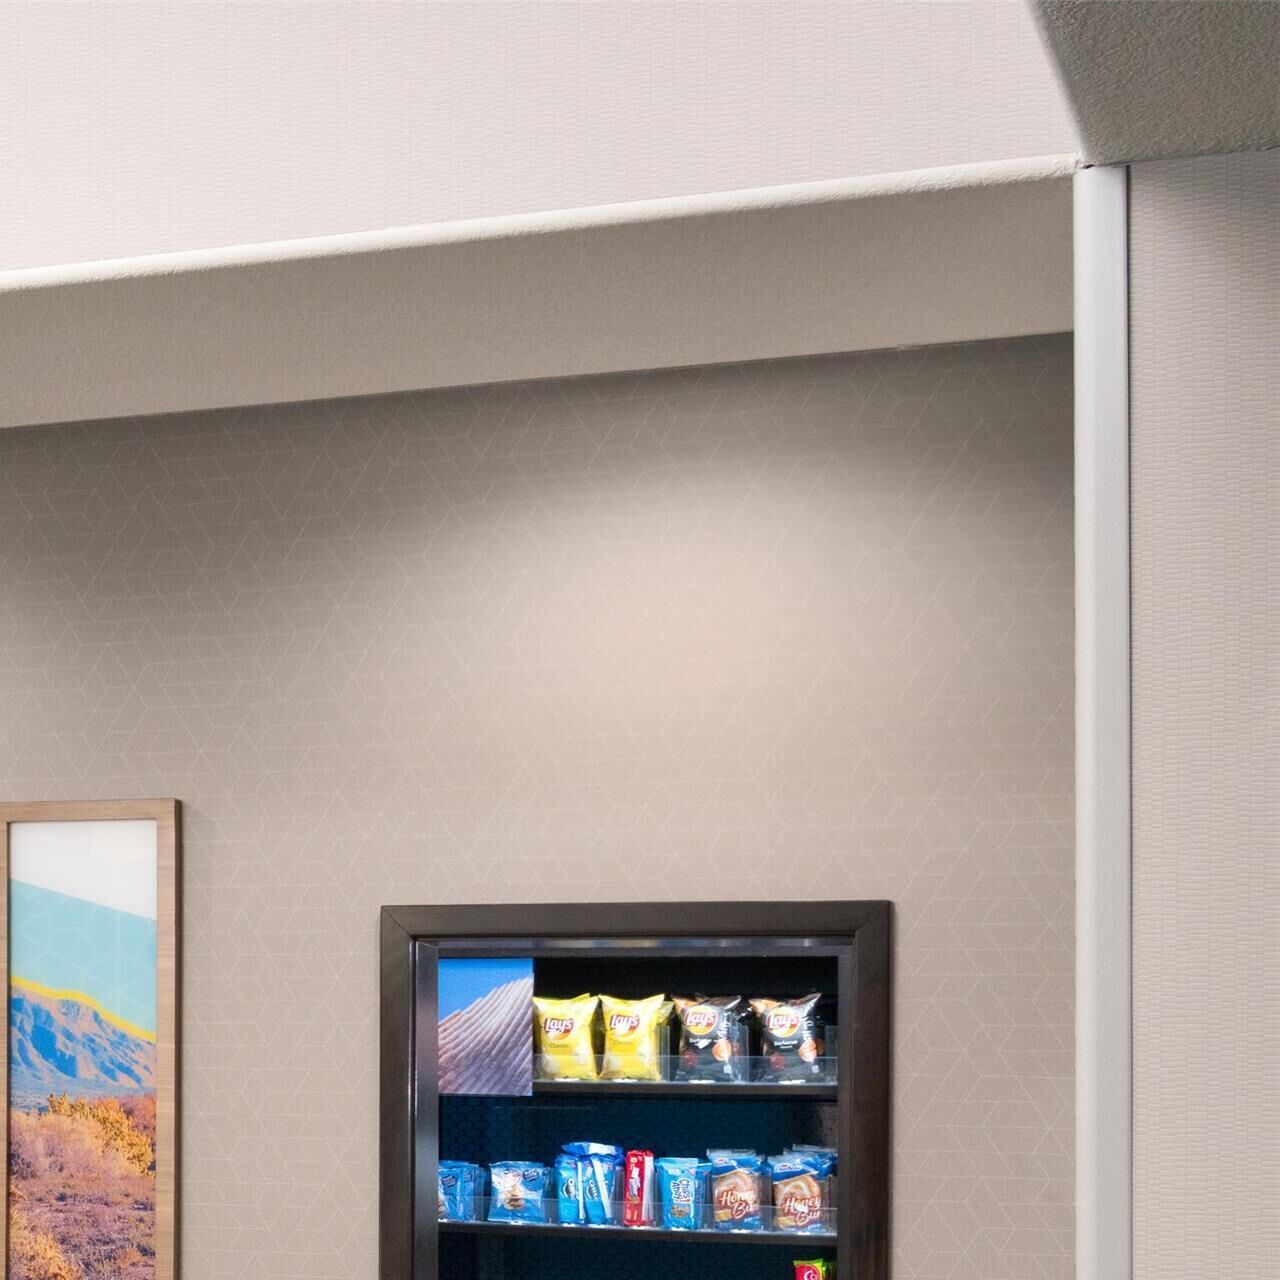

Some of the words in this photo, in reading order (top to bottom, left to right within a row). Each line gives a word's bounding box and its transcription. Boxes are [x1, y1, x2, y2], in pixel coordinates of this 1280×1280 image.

[544, 1018, 573, 1033] Lay's
[610, 1015, 639, 1031] Lay's
[687, 1009, 716, 1028] Lay's
[768, 1013, 800, 1030] Lay's
